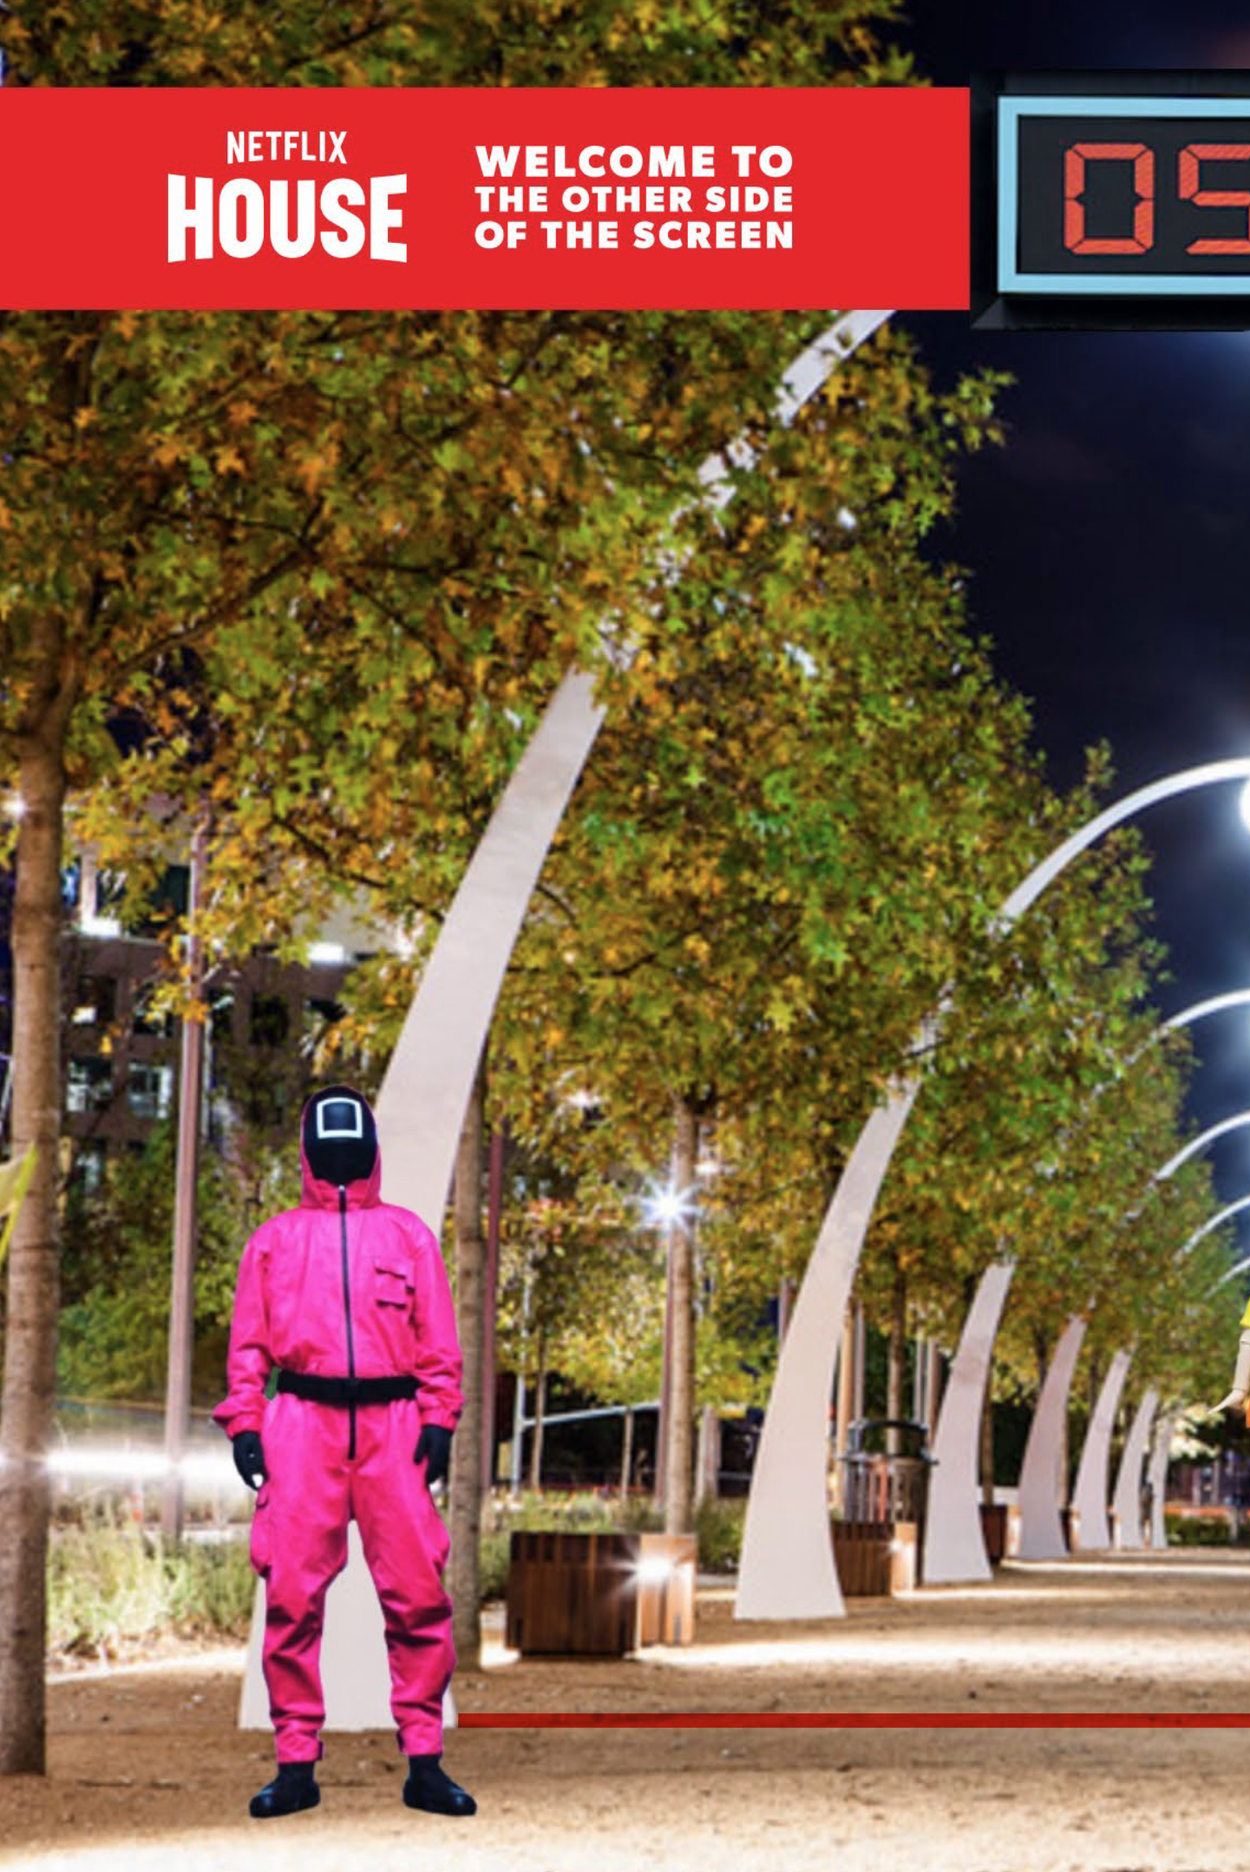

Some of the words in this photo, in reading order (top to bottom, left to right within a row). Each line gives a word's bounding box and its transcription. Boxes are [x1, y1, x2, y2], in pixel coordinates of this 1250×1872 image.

[227, 130, 348, 165] NETFLIX
[475, 145, 715, 178] WELCOME
[731, 145, 793, 178] TO
[474, 185, 548, 213] THE
[561, 185, 693, 213] OTHER
[705, 185, 793, 213] SIDE
[167, 173, 408, 263] HOUSE
[474, 220, 527, 249] OF
[540, 220, 619, 249] THE
[633, 220, 793, 249] SCREEN
